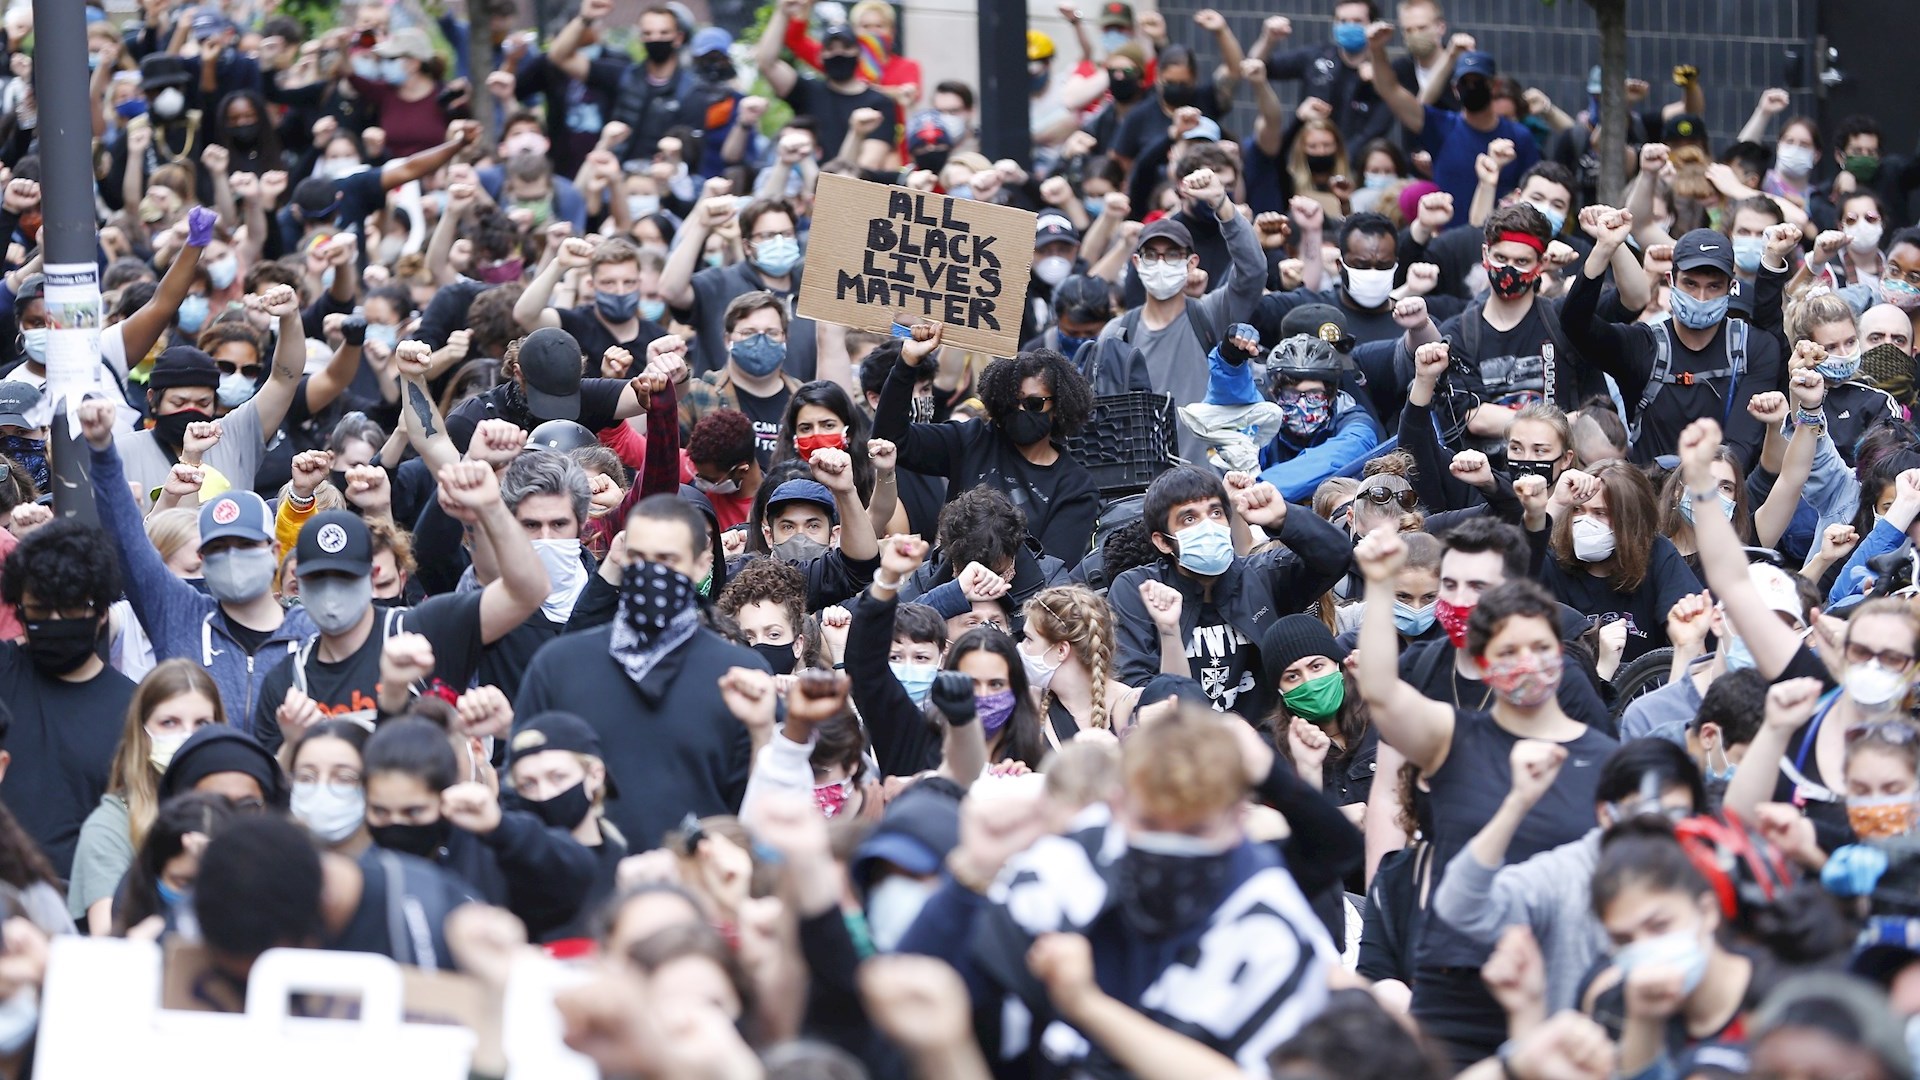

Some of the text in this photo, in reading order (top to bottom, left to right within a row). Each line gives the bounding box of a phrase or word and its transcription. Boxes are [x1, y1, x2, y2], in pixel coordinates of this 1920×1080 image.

[888, 190, 970, 233] ALL
[867, 218, 1002, 269] BLACK
[863, 249, 1002, 298] LIVES
[836, 268, 1001, 331] MATTER
[1680, 304, 1721, 325] BLM
[752, 421, 777, 434] CAN
